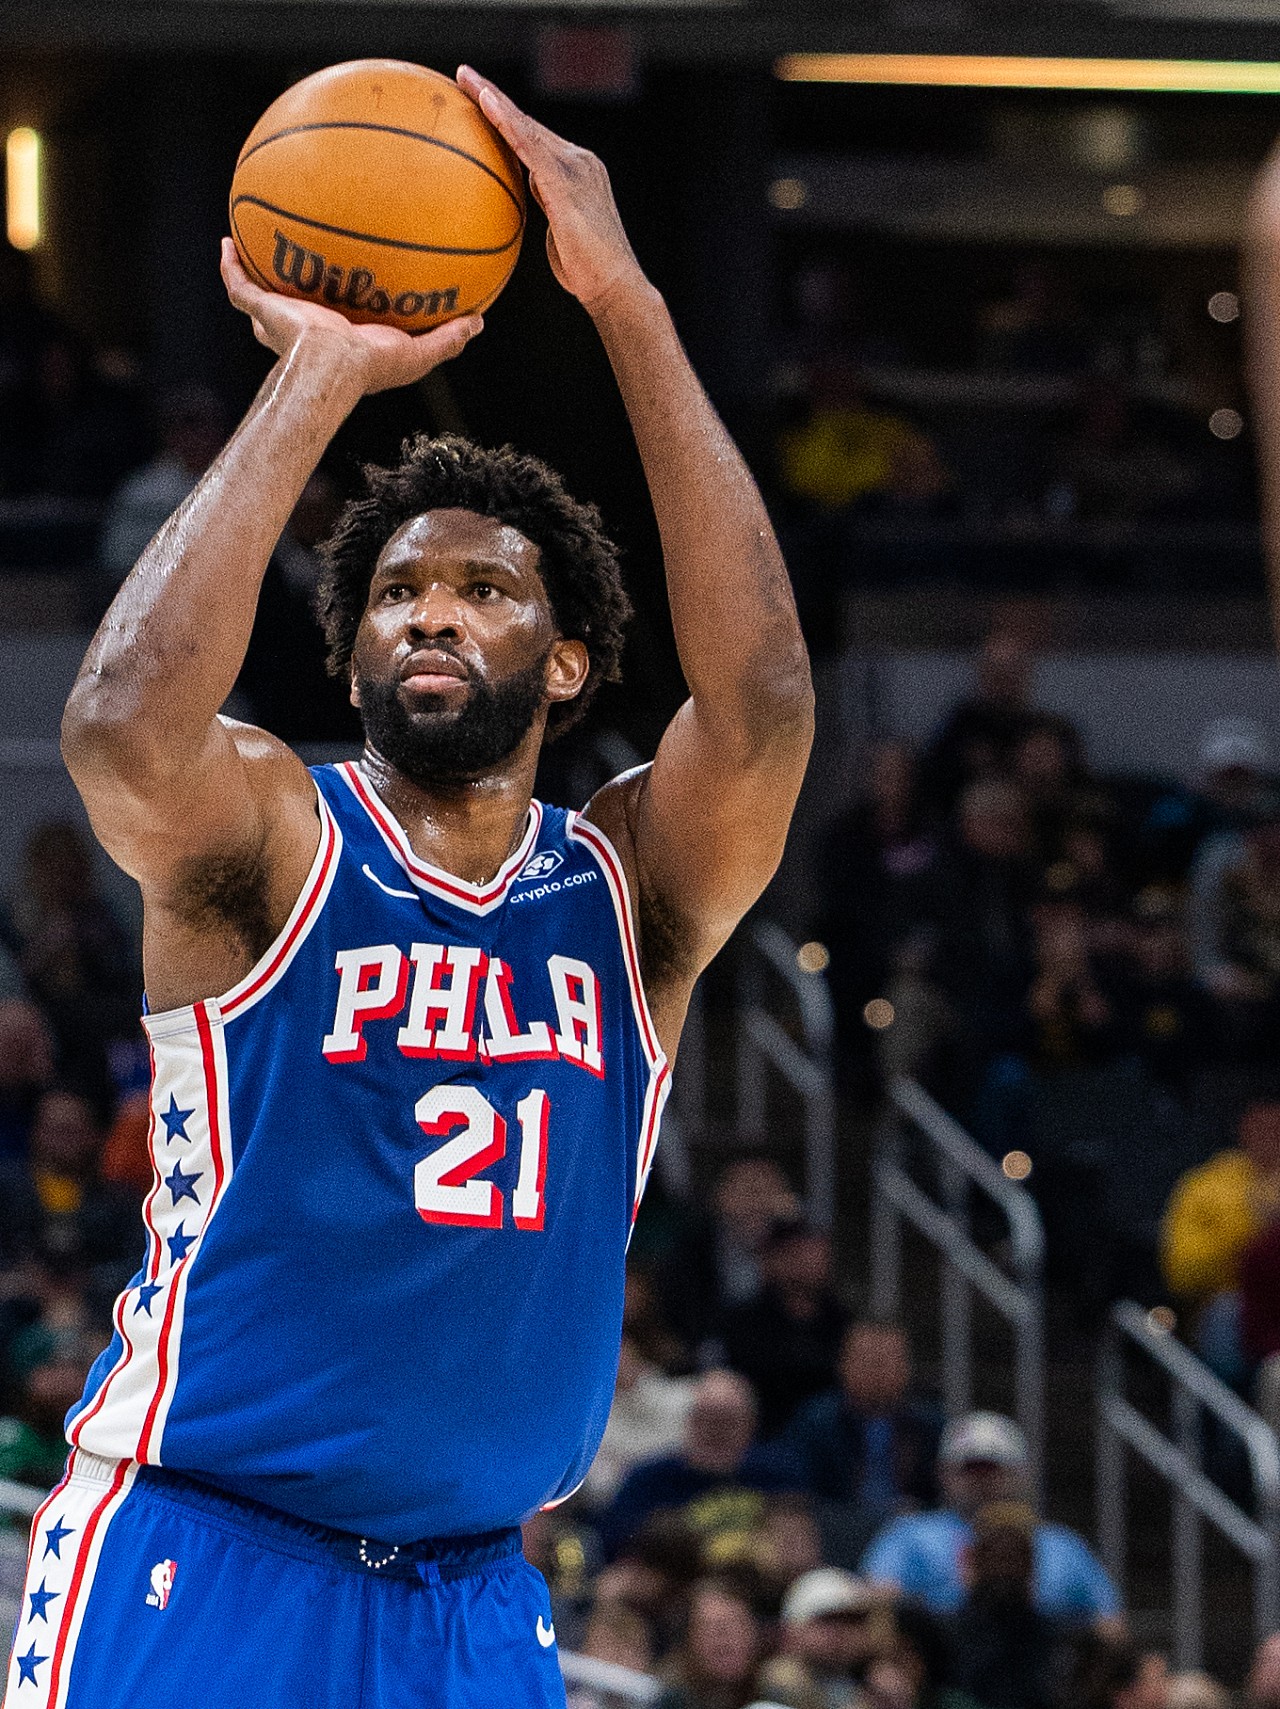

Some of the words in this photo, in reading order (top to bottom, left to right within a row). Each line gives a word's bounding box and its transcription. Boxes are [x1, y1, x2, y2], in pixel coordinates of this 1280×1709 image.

[273, 229, 460, 317] Wilson
[509, 870, 598, 904] crypto.com
[322, 943, 605, 1079] PHLA
[414, 1085, 551, 1230] 21
